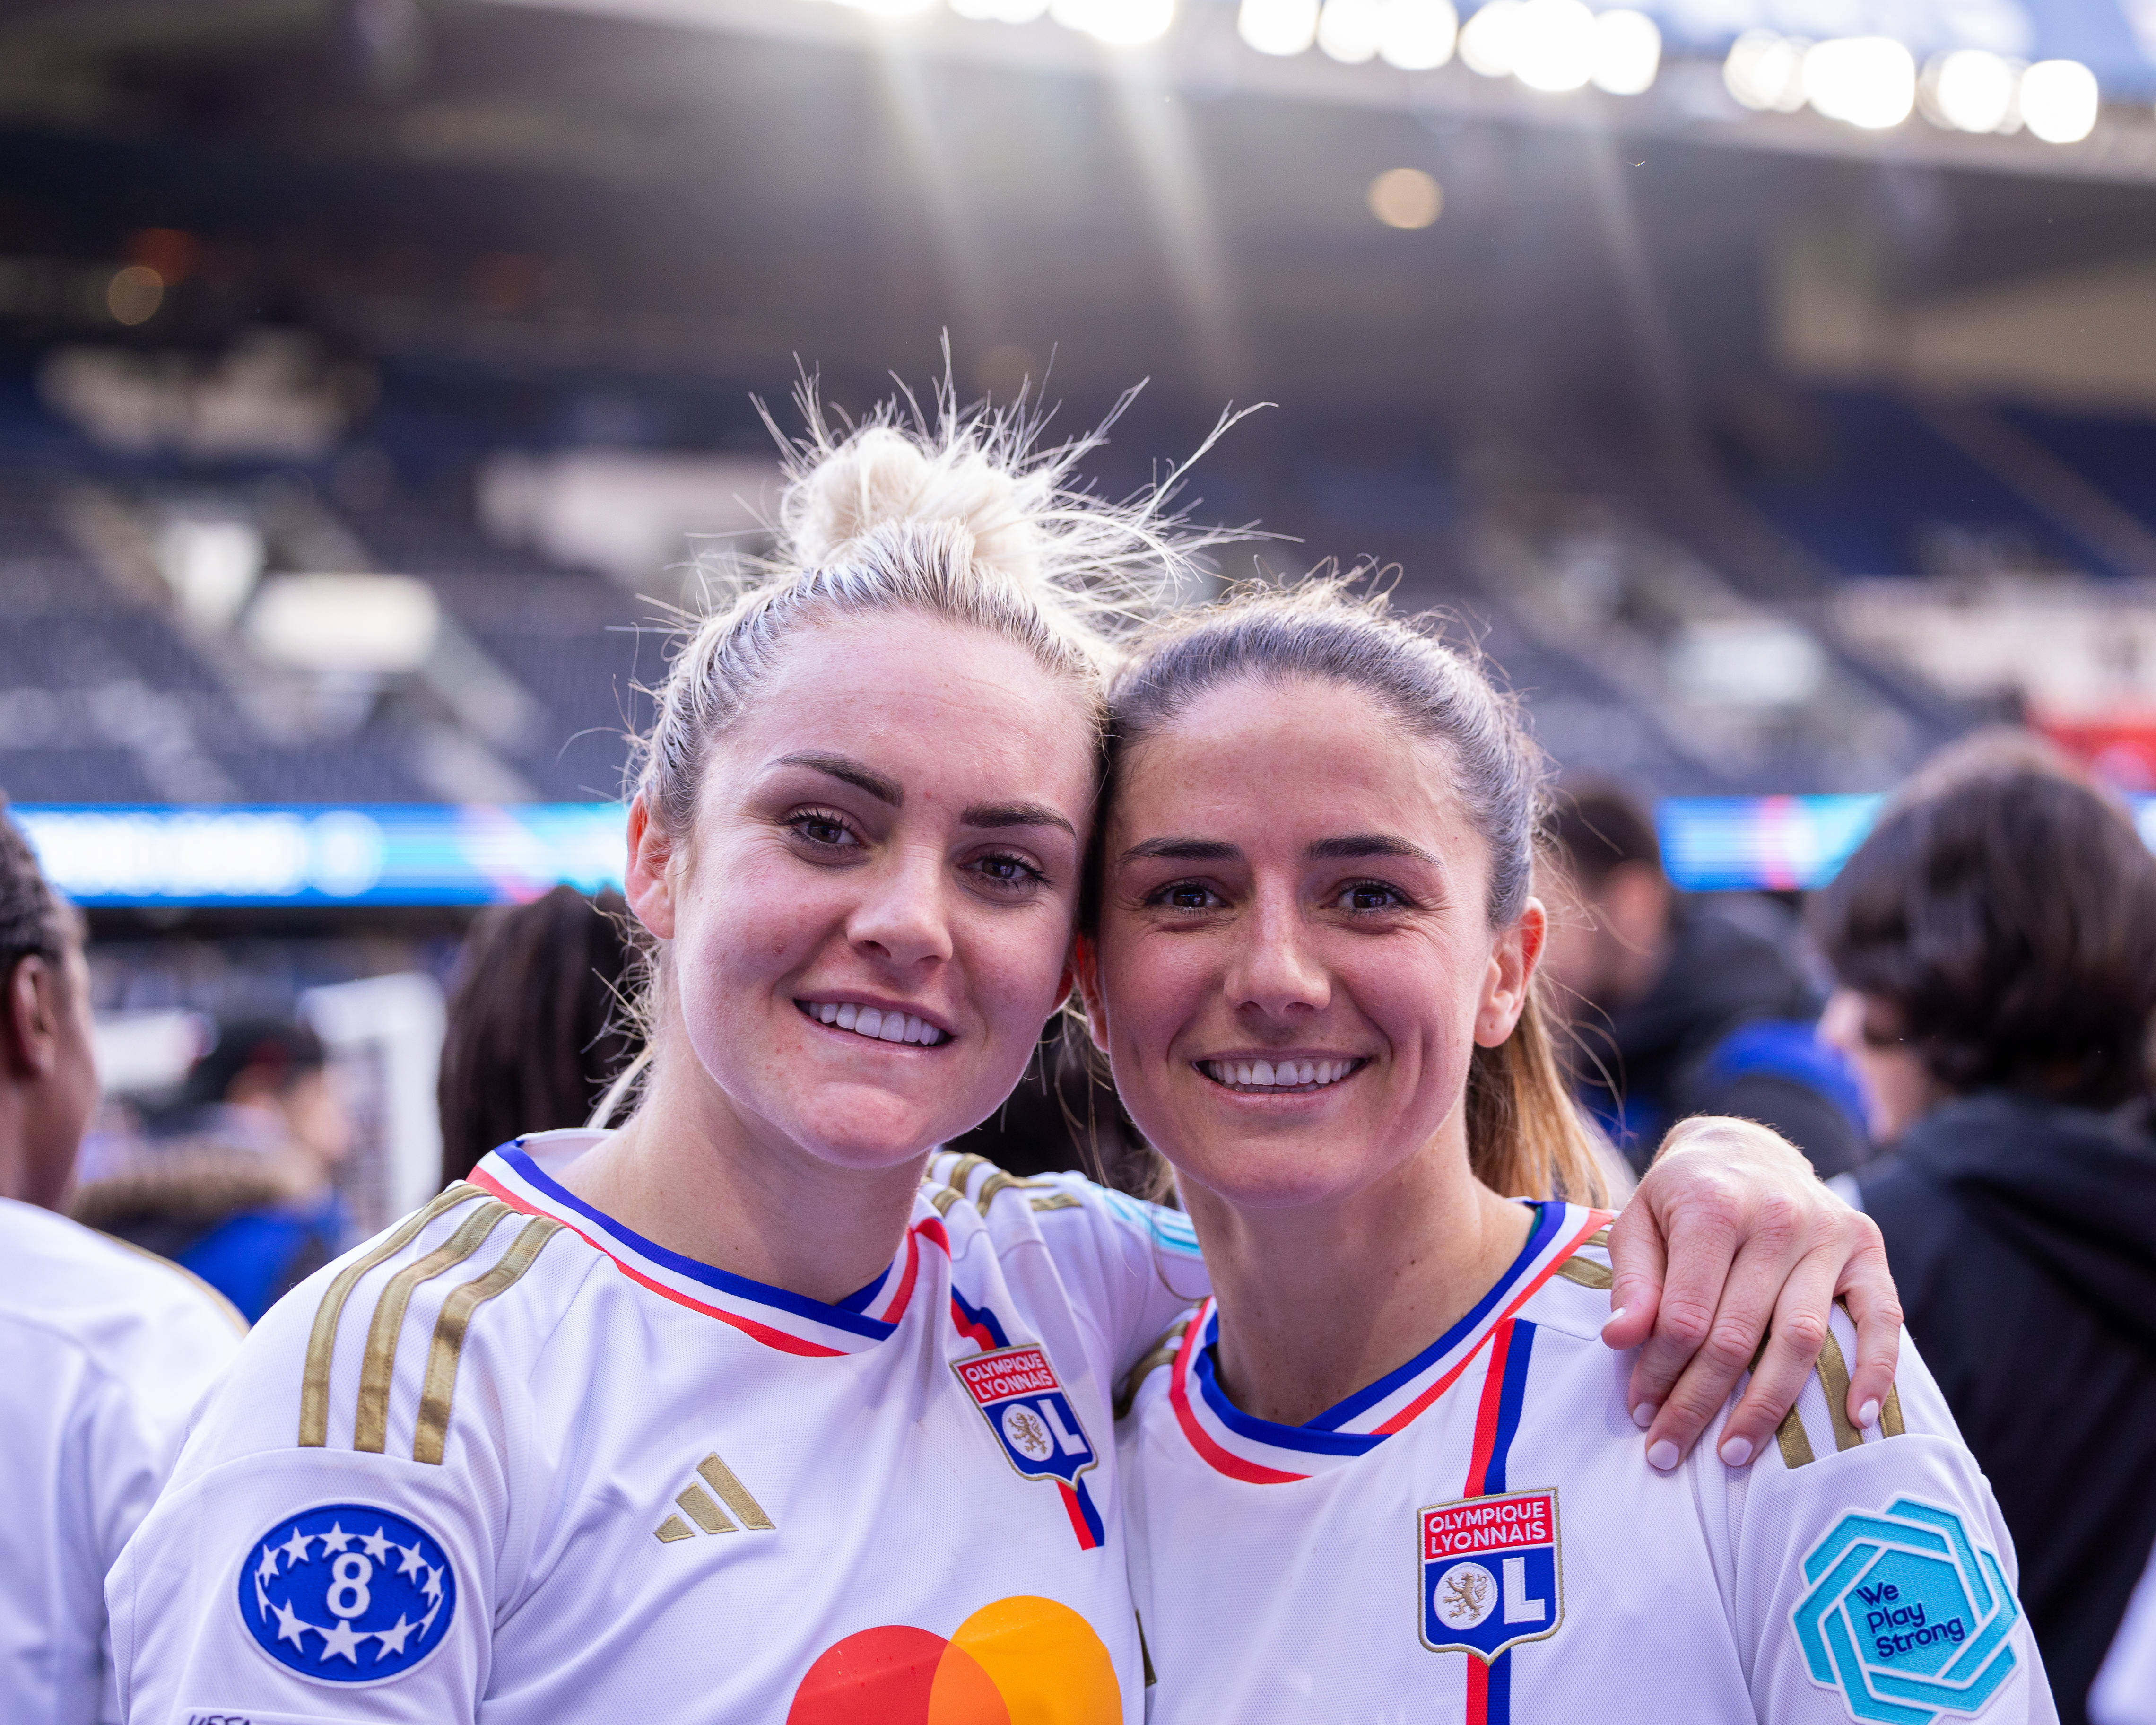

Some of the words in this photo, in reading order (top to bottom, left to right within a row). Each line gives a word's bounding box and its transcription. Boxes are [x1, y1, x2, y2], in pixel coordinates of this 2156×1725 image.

[966, 1353, 1044, 1381] OLYMPIQUE
[975, 1369, 1053, 1399] LYONNAIS
[1429, 1501, 1545, 1533] OLYMPIQUE
[1431, 1521, 1546, 1555] LYONNAIS
[327, 1552, 372, 1618] 8
[1856, 1582, 1899, 1606] We
[1866, 1603, 1925, 1634] Play
[1875, 1617, 1965, 1657] Strong
